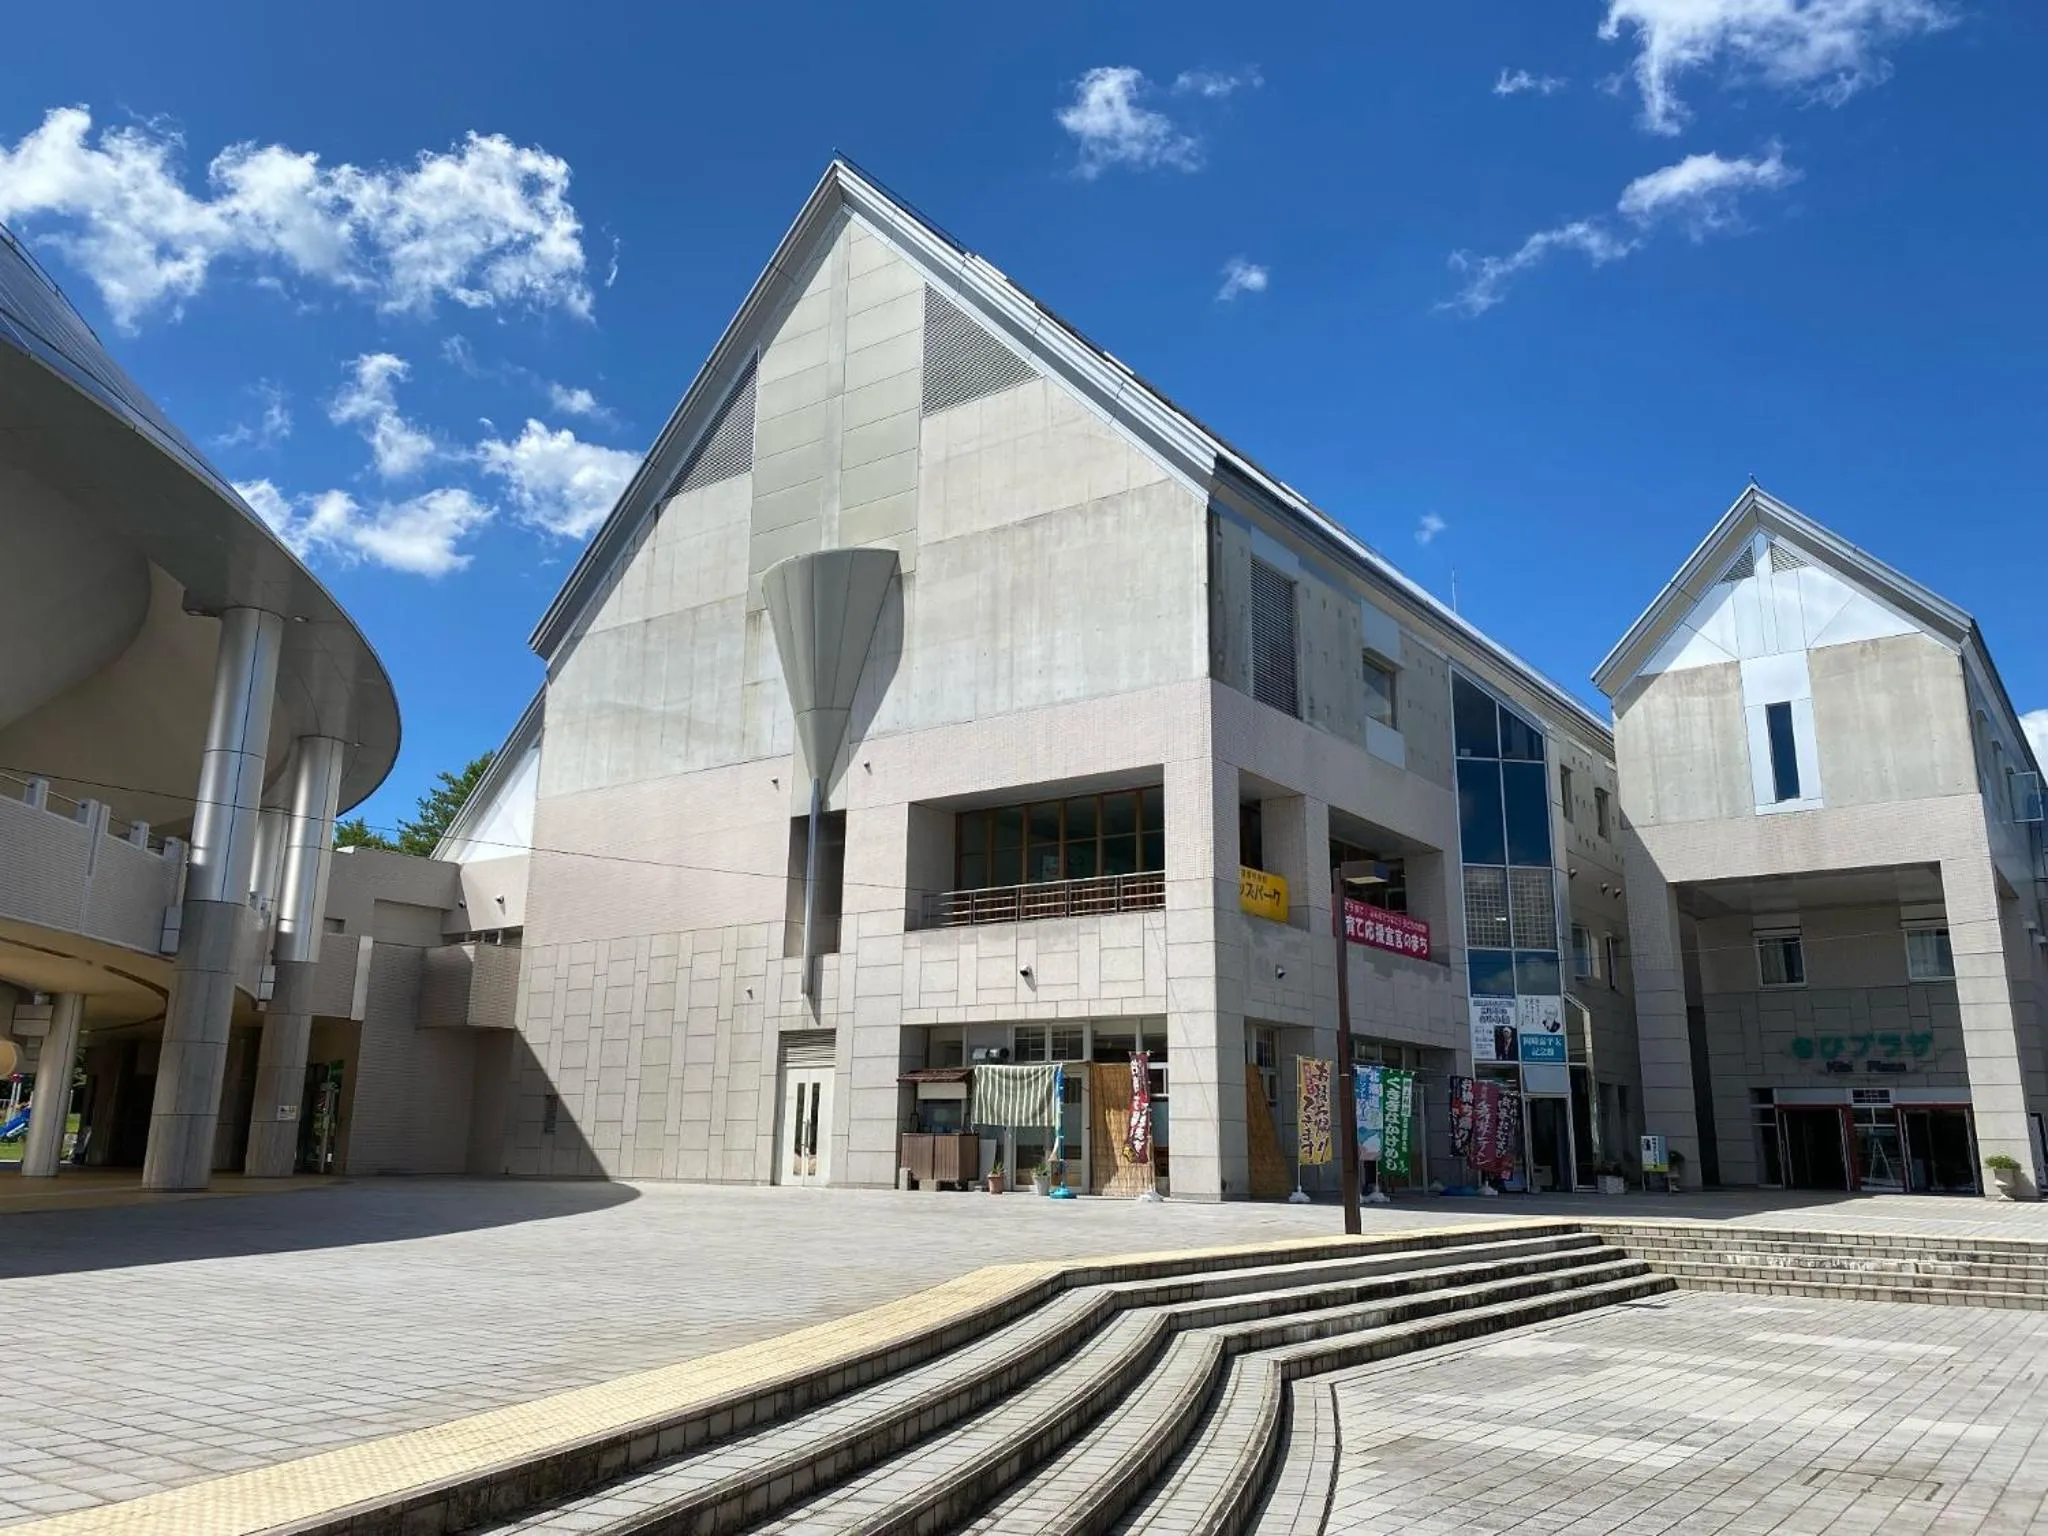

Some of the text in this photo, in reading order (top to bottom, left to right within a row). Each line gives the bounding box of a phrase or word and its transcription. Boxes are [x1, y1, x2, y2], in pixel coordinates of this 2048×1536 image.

[1345, 914, 1428, 955] 育て応援宣言のまち
